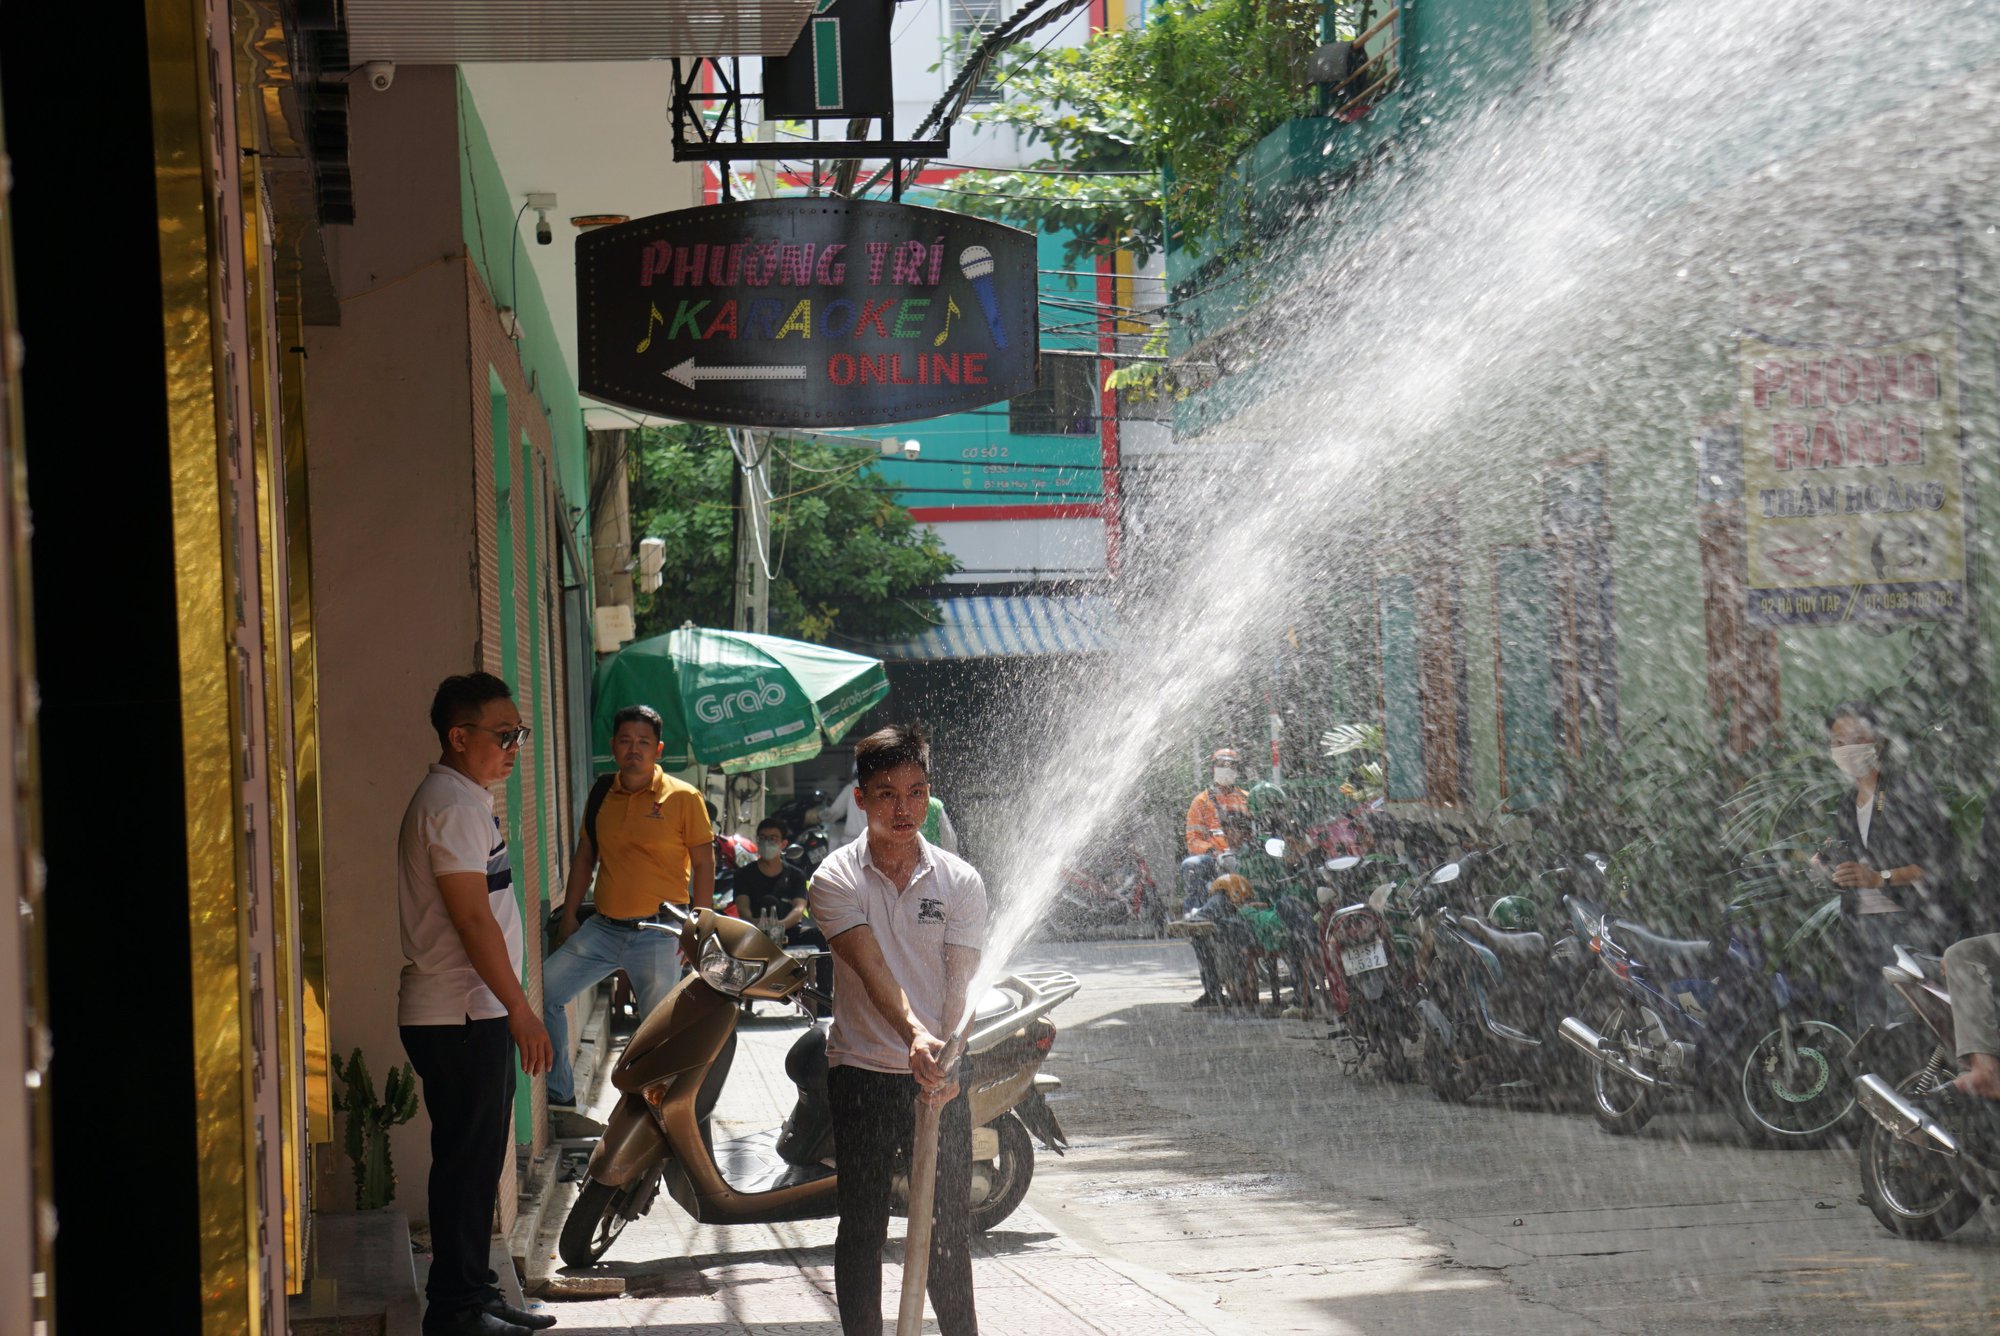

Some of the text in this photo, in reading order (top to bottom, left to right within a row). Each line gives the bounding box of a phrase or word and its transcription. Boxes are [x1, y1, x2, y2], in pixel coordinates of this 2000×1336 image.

[640, 236, 944, 286] PHƯƠNG TRÍ
[667, 299, 930, 340] KARAOKE
[827, 353, 988, 385] ONLINE
[1000, 447, 1008, 457] 2
[1844, 476, 1945, 514] HOÀNG
[1761, 599, 1774, 615] 92
[1796, 596, 1817, 613] HUY
[1884, 592, 1909, 609] 0935
[695, 677, 786, 723] Grab
[840, 690, 862, 711] Grab
[1514, 915, 1536, 925] Grab
